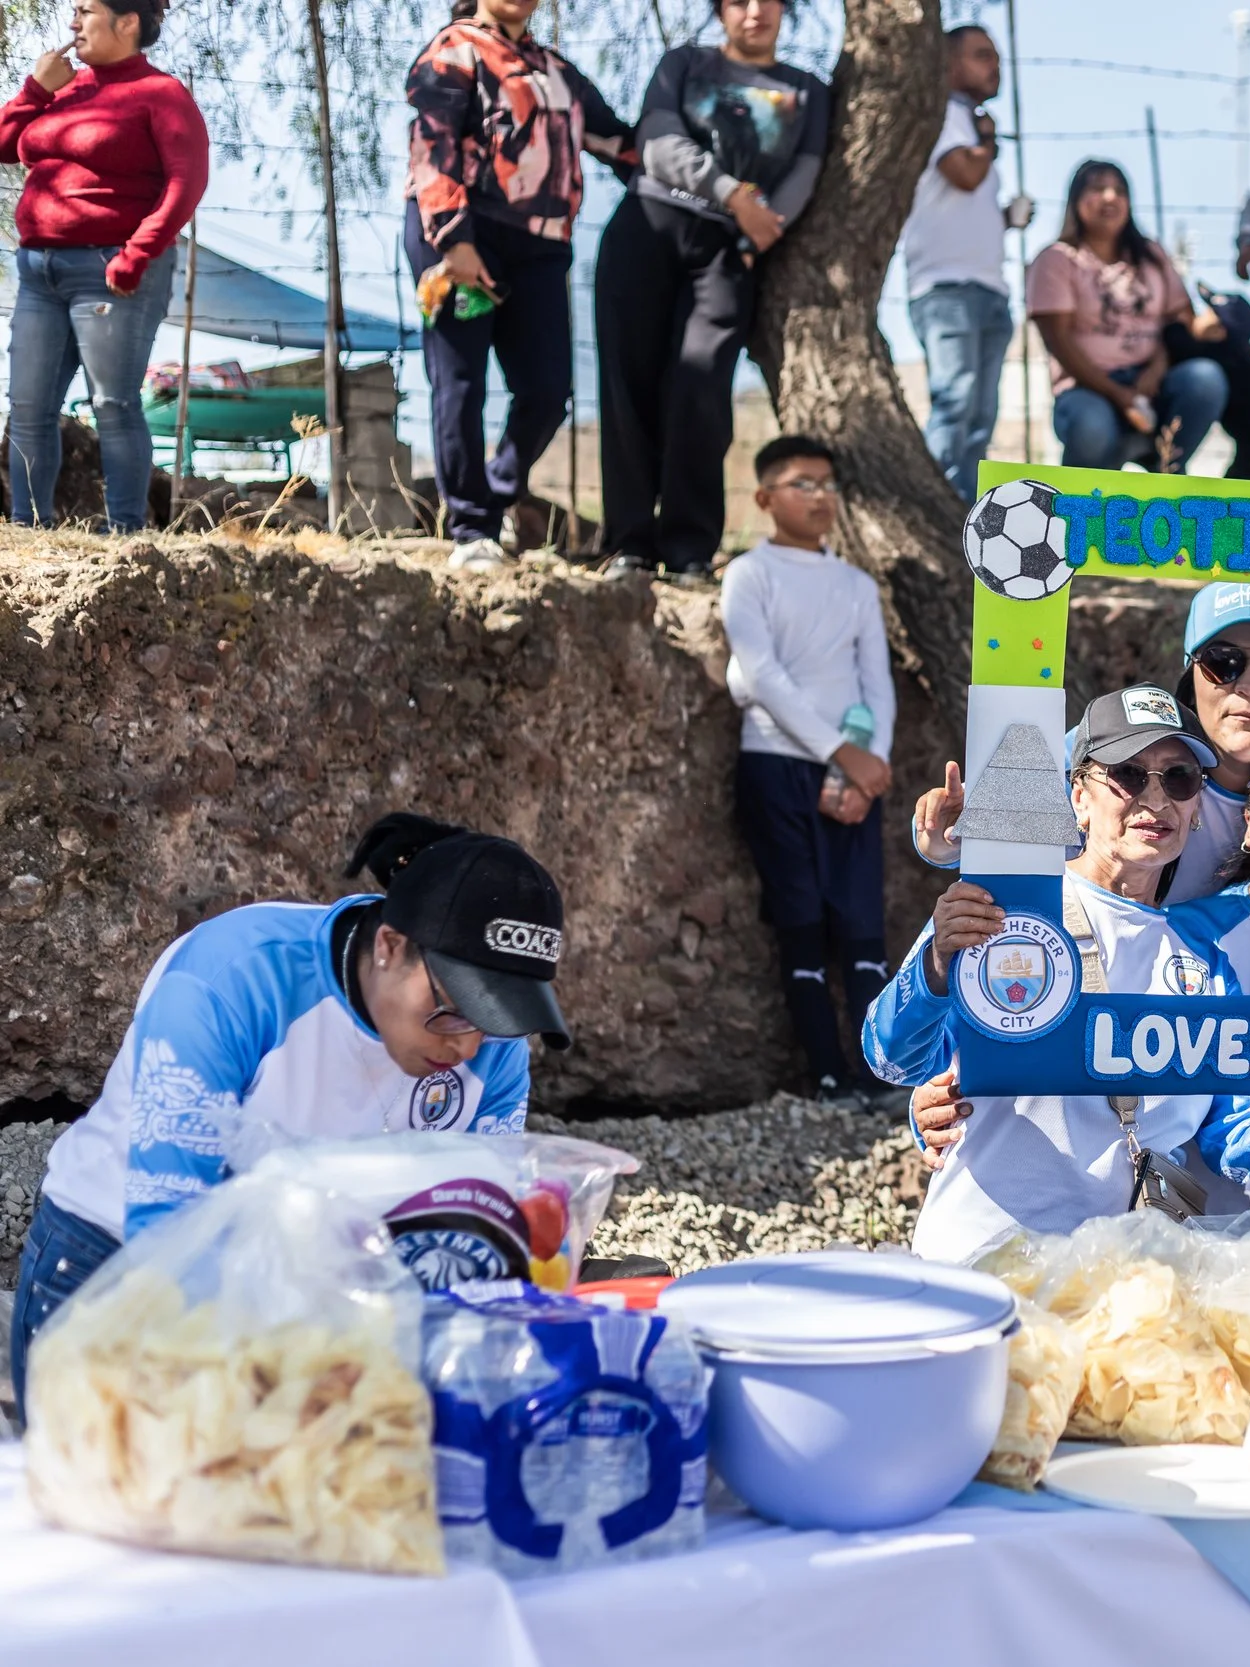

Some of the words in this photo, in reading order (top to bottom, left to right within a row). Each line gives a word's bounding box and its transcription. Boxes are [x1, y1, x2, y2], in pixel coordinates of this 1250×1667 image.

[963, 971, 975, 980] 18
[1057, 969, 1069, 977] 94
[1000, 1016, 1036, 1028] CITY
